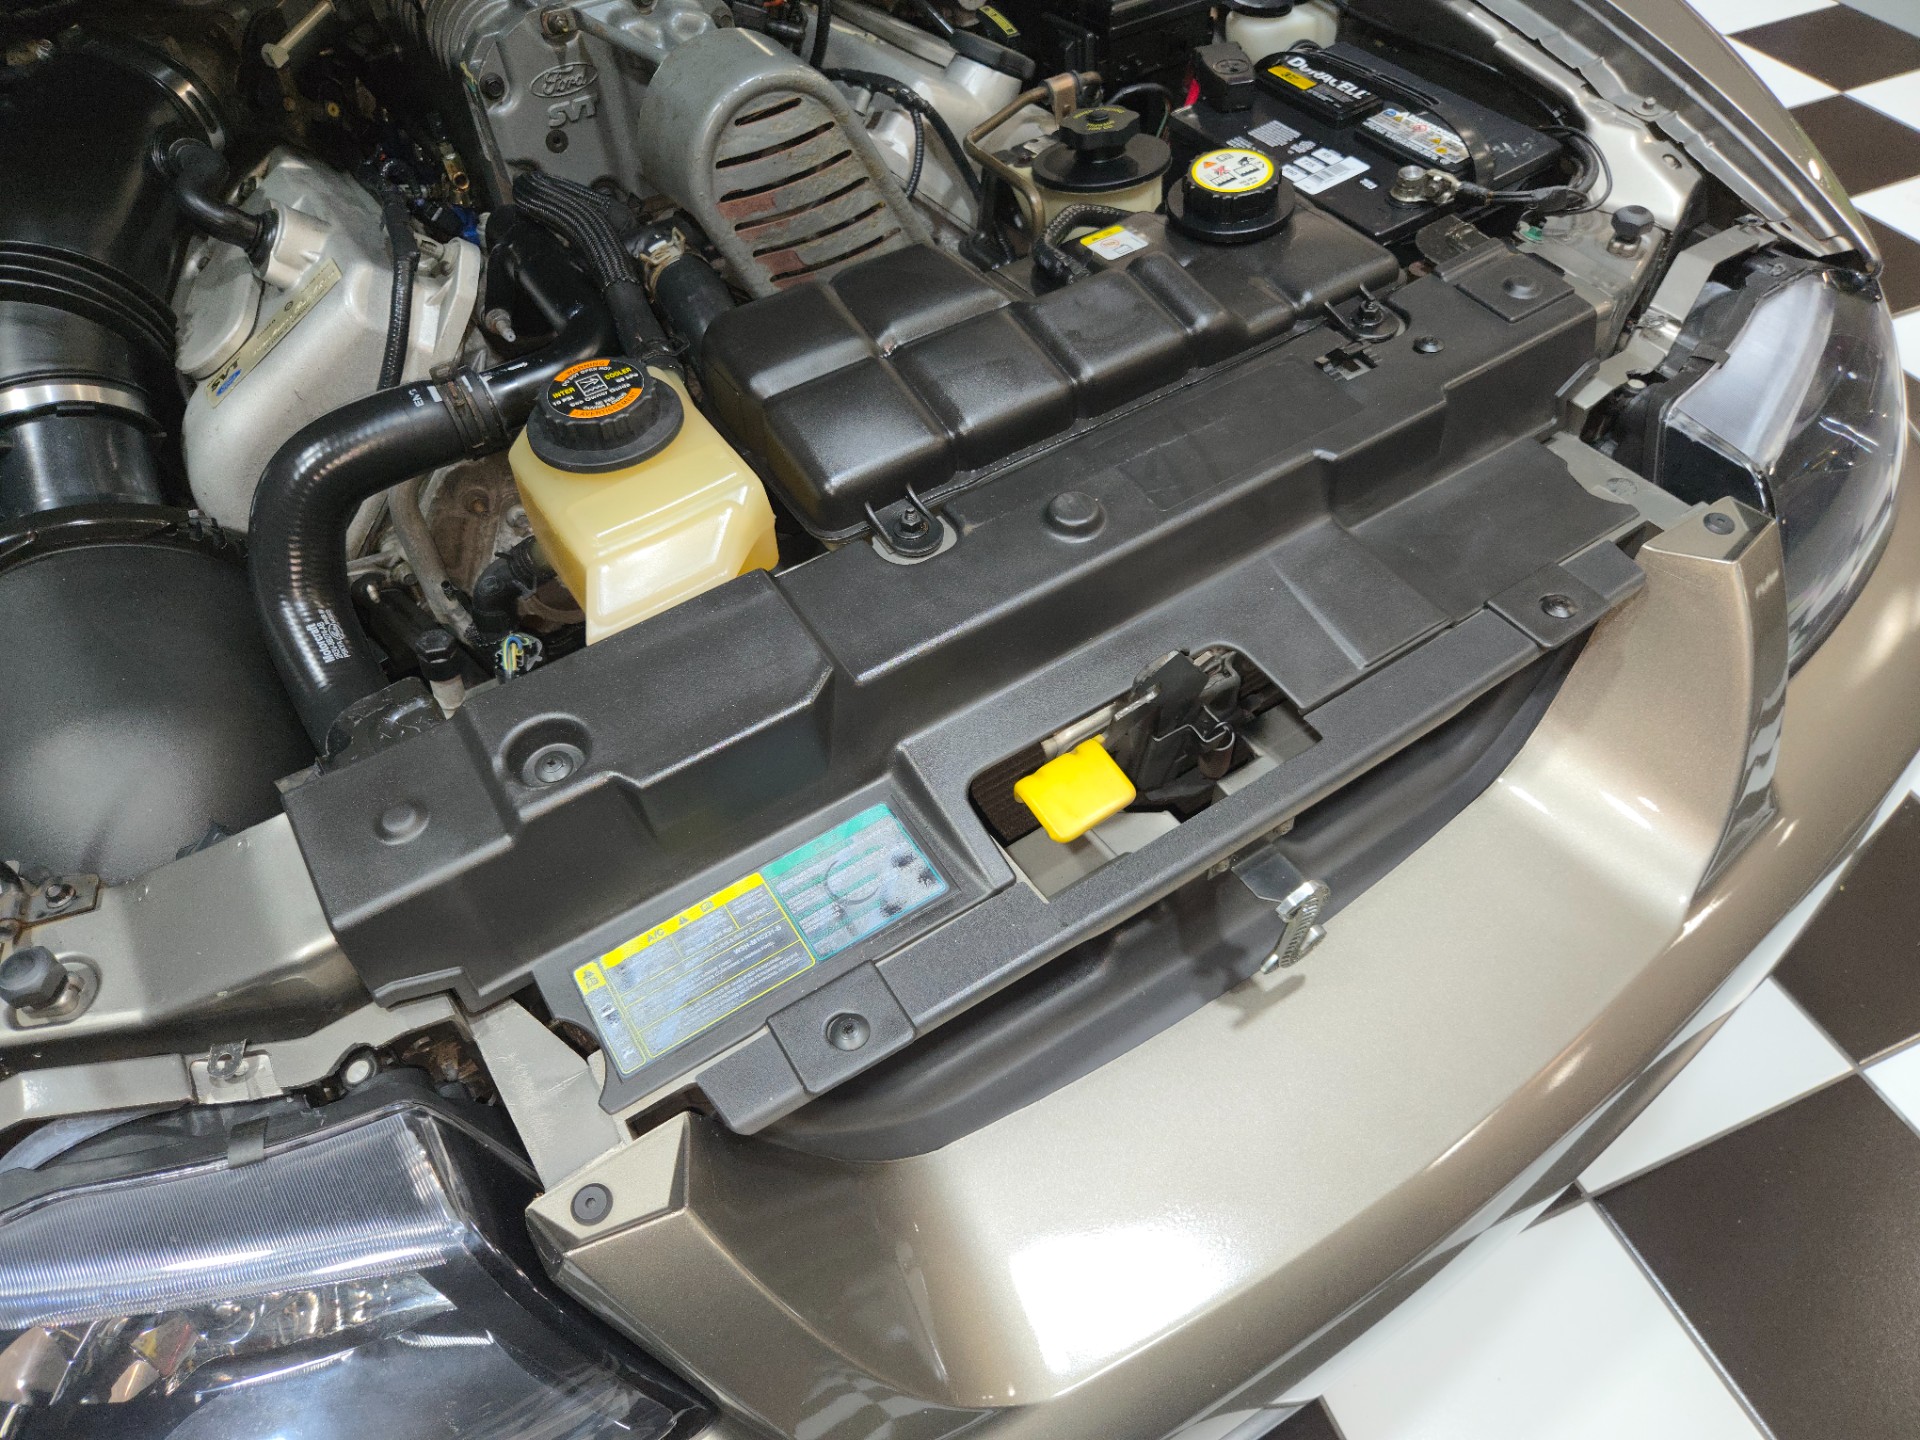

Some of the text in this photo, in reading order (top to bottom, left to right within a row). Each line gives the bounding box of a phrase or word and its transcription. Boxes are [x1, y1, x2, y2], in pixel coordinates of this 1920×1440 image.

[541, 64, 590, 96] Ford
[547, 95, 596, 128] SVT
[604, 367, 632, 380] COOLER
[552, 386, 576, 399] INTER
[306, 622, 336, 663] Motorcraft
[647, 928, 664, 943] A/C
